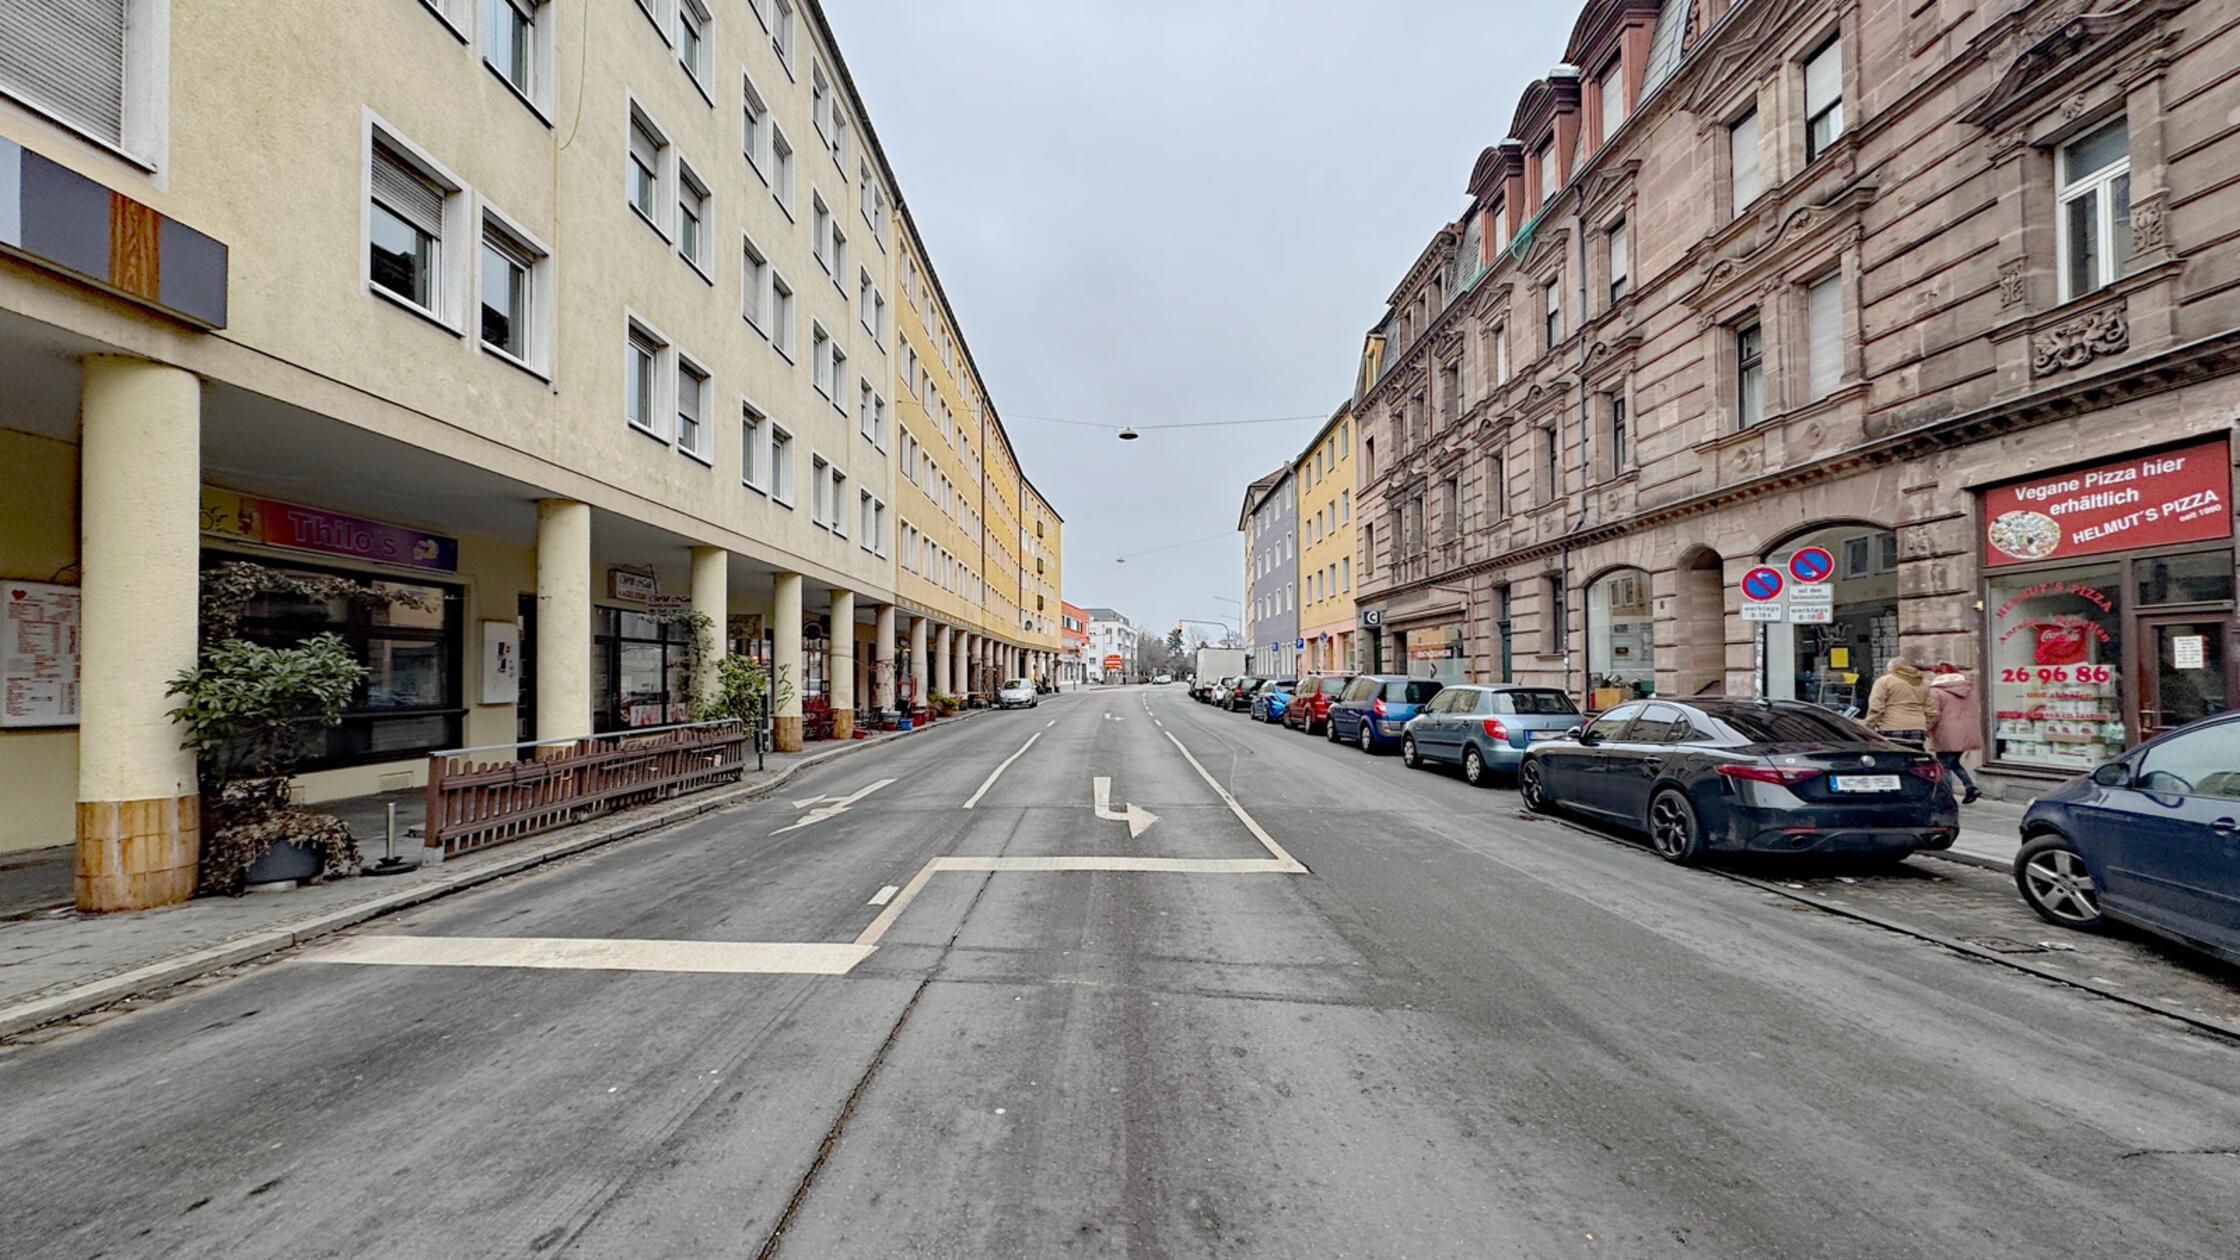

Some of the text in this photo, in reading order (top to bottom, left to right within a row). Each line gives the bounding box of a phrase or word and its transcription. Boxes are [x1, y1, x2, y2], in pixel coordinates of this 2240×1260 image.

[2015, 457, 2186, 501] Vegane Pizza hier
[2049, 487, 2140, 516] erhältlich
[2161, 489, 2219, 517] PIZZA
[2179, 510, 2197, 522] seit
[2069, 582, 2112, 613] PIZZA
[2001, 665, 2110, 686] 26 96 86
